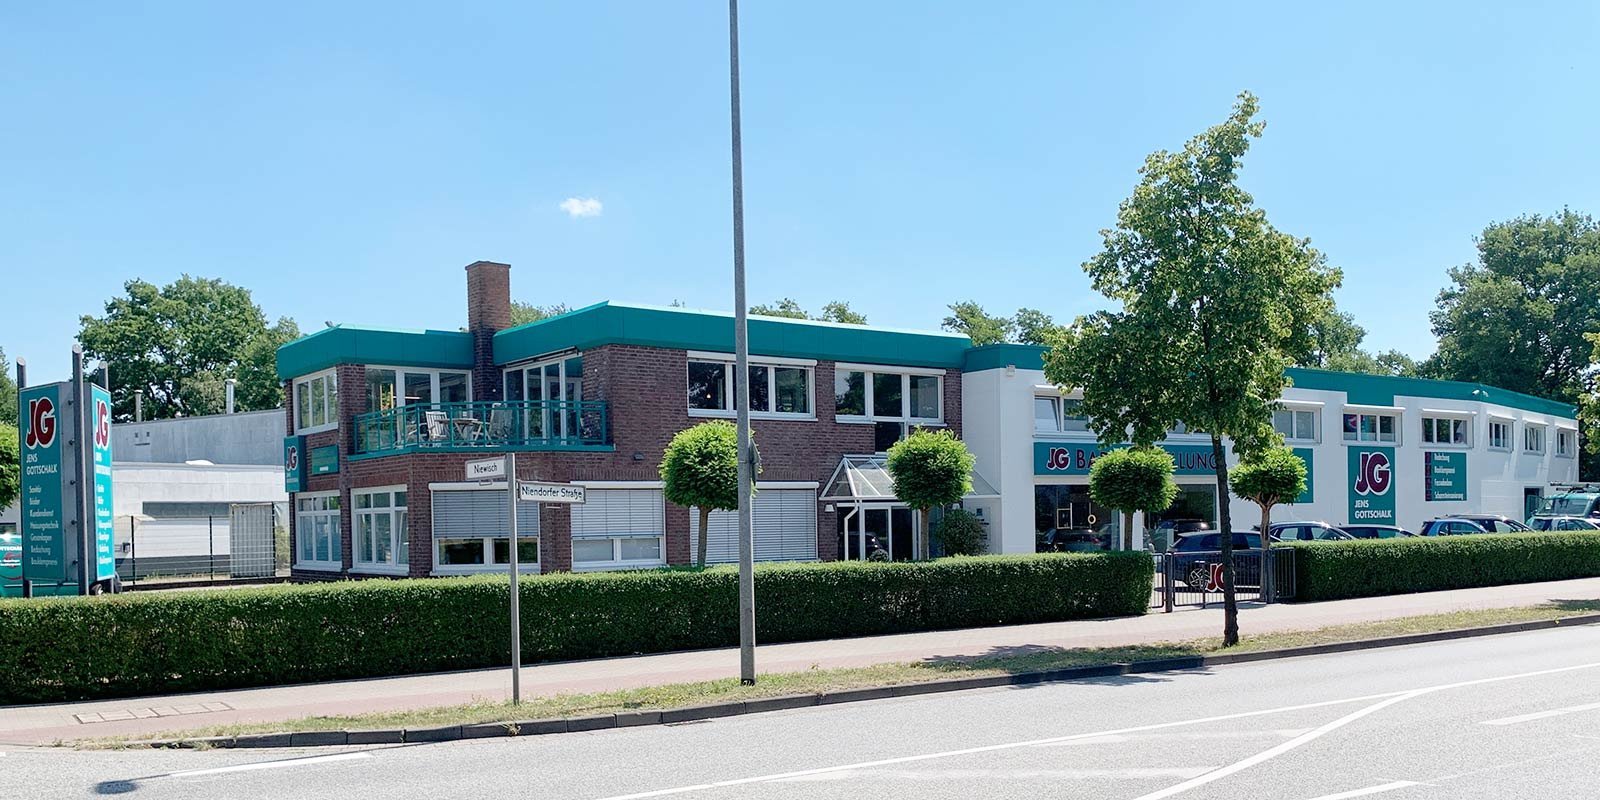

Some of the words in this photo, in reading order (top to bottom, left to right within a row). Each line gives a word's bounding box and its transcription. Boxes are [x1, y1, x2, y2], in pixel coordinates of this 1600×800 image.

[26, 397, 56, 449] JG
[95, 399, 109, 450] JG
[26, 453, 38, 463] JENS
[1046, 447, 1070, 470] JG
[26, 464, 58, 475] GOTTSCHALK
[473, 463, 498, 473] Niewisch
[1354, 452, 1391, 496] JG
[521, 486, 559, 497] Niendorfer
[561, 488, 582, 500] Straße
[1355, 499, 1369, 508] JENS
[1355, 510, 1392, 519] GOTTSCHALK
